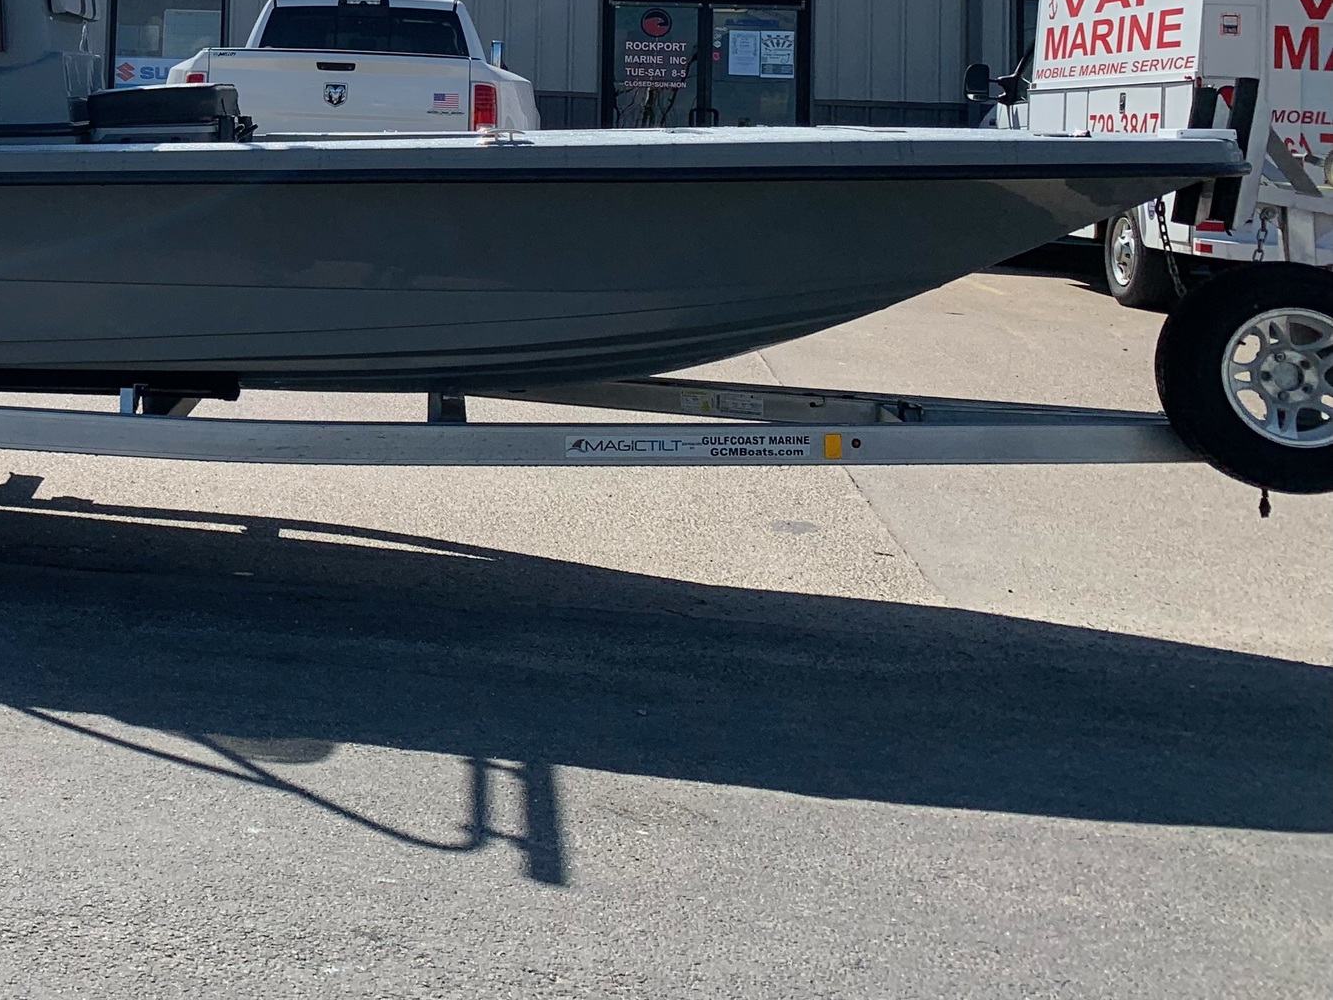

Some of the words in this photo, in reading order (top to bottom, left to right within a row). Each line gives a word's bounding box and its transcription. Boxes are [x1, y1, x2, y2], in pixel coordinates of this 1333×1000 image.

[1044, 7, 1184, 61] MARINE
[625, 41, 687, 52] ROCKPORT
[624, 55, 664, 64] MARINE
[669, 56, 687, 65] INC
[625, 67, 667, 77] TUE-SAT
[671, 69, 687, 78] 8-5
[1035, 65, 1077, 80] MOBILE
[1078, 61, 1129, 76] MARINE
[1131, 55, 1196, 73] SERVICE
[1271, 109, 1333, 125] MOBIL
[584, 439, 683, 452] MAGICTILT
[701, 436, 765, 446] GULFCOAST
[768, 435, 811, 445] MARINE
[709, 447, 804, 457] GCMBoats.com
